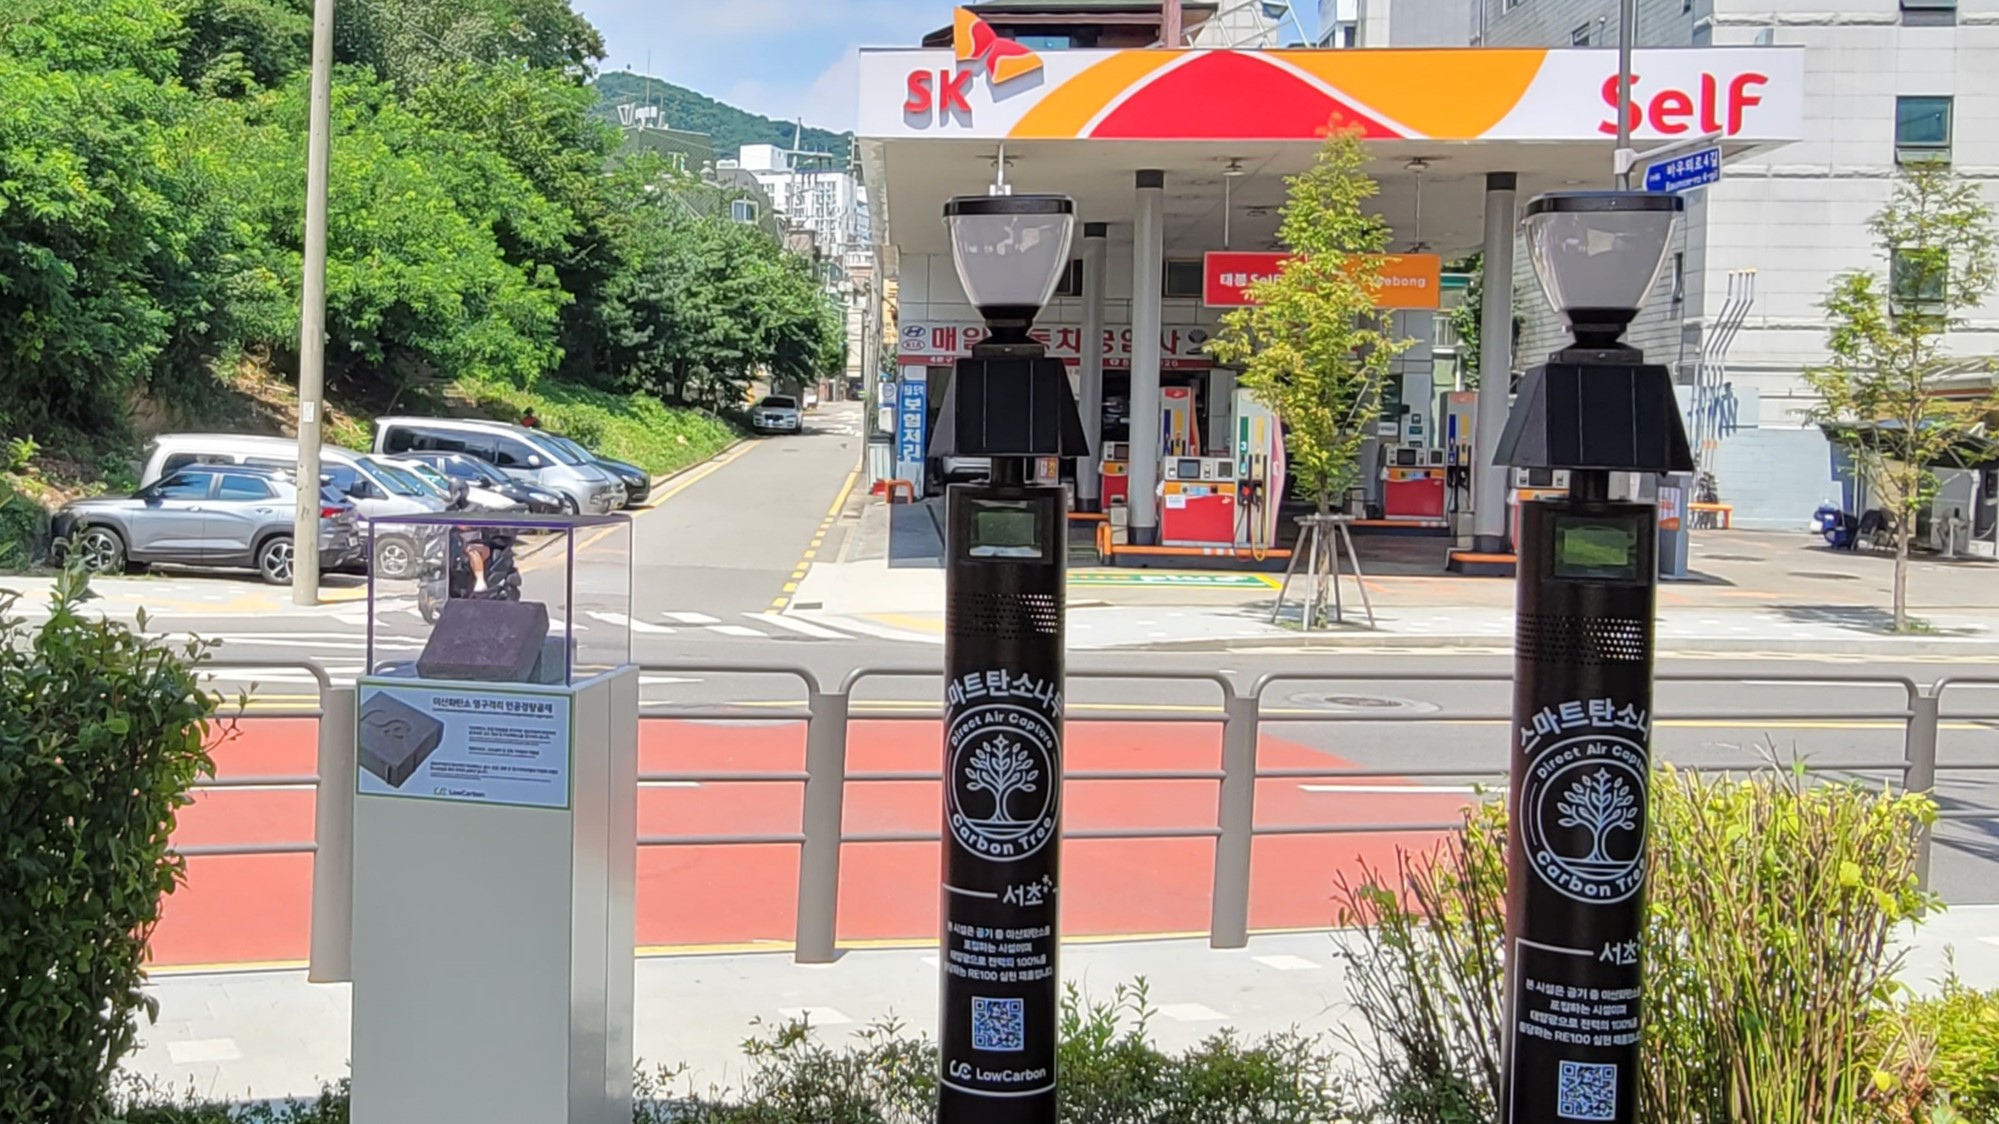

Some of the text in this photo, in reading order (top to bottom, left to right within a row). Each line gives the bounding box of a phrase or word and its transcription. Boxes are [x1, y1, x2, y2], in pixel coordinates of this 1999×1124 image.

[905, 69, 973, 113] SK
[1598, 72, 1769, 135] Self
[433, 697, 472, 708] 이산화탄소
[951, 711, 1053, 749] Direct Air Capture
[1536, 747, 1581, 780] Direct
[1586, 742, 1608, 755] Air
[952, 813, 1052, 855] Carbon Tree
[1536, 850, 1646, 896] Carbon Tree
[1599, 939, 1638, 965] 서초
[968, 969, 997, 981] RE100
[1535, 981, 1565, 997] 시설은
[1566, 986, 1587, 1000] 공기
[1554, 1031, 1591, 1045] RE100
[976, 1067, 1046, 1082] LowCarbon
